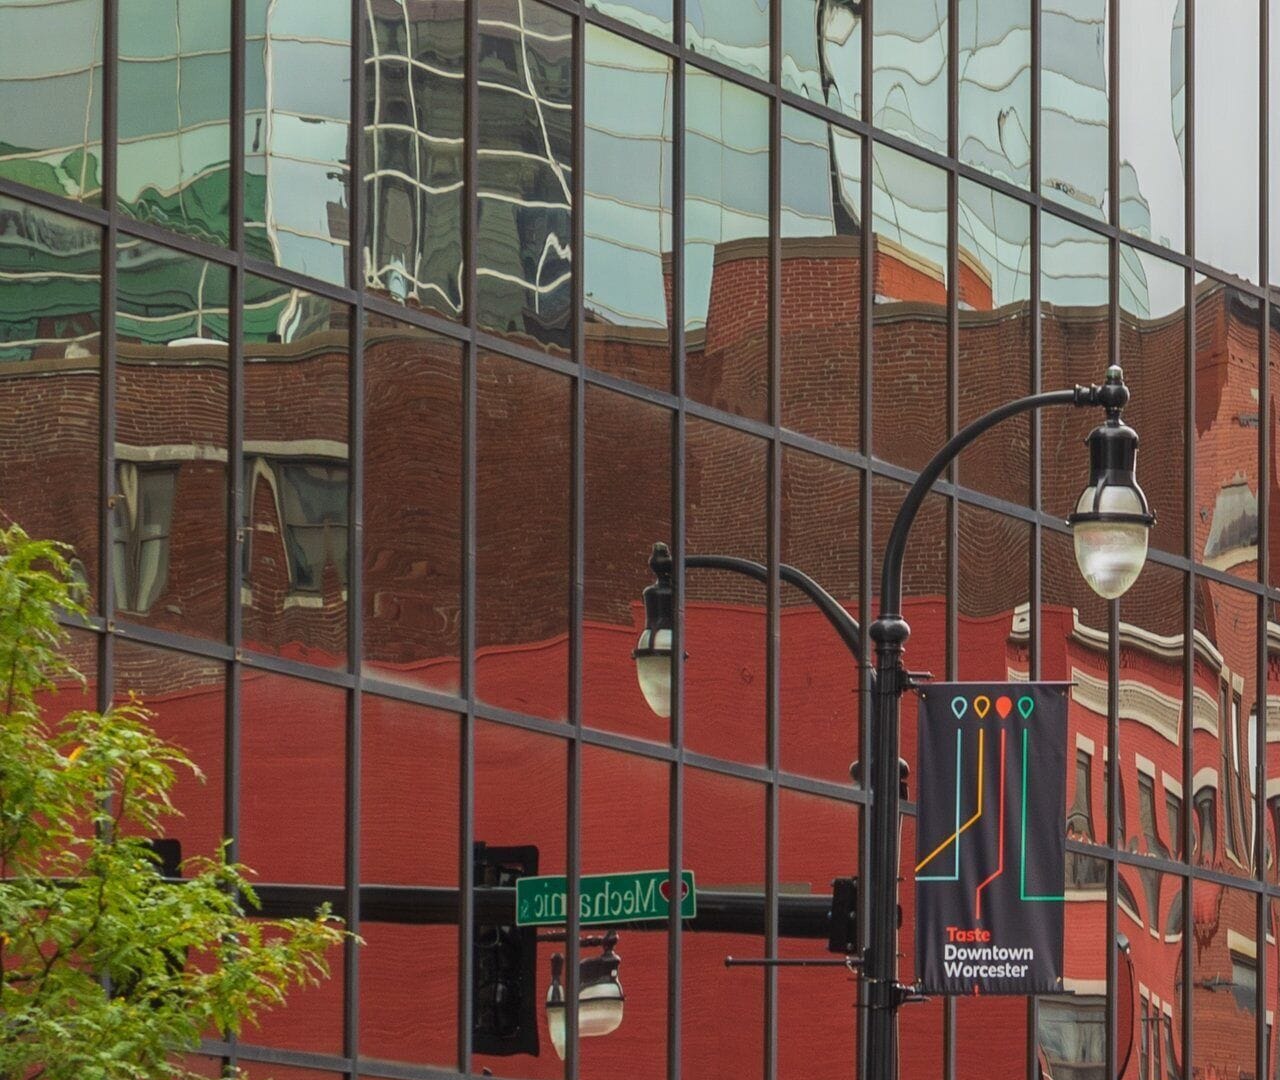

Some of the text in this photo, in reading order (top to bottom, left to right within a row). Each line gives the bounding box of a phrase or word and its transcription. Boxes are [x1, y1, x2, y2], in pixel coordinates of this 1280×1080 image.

[946, 926, 991, 942] Taste
[944, 944, 1034, 960] Downtown
[944, 961, 1028, 978] Worcester
